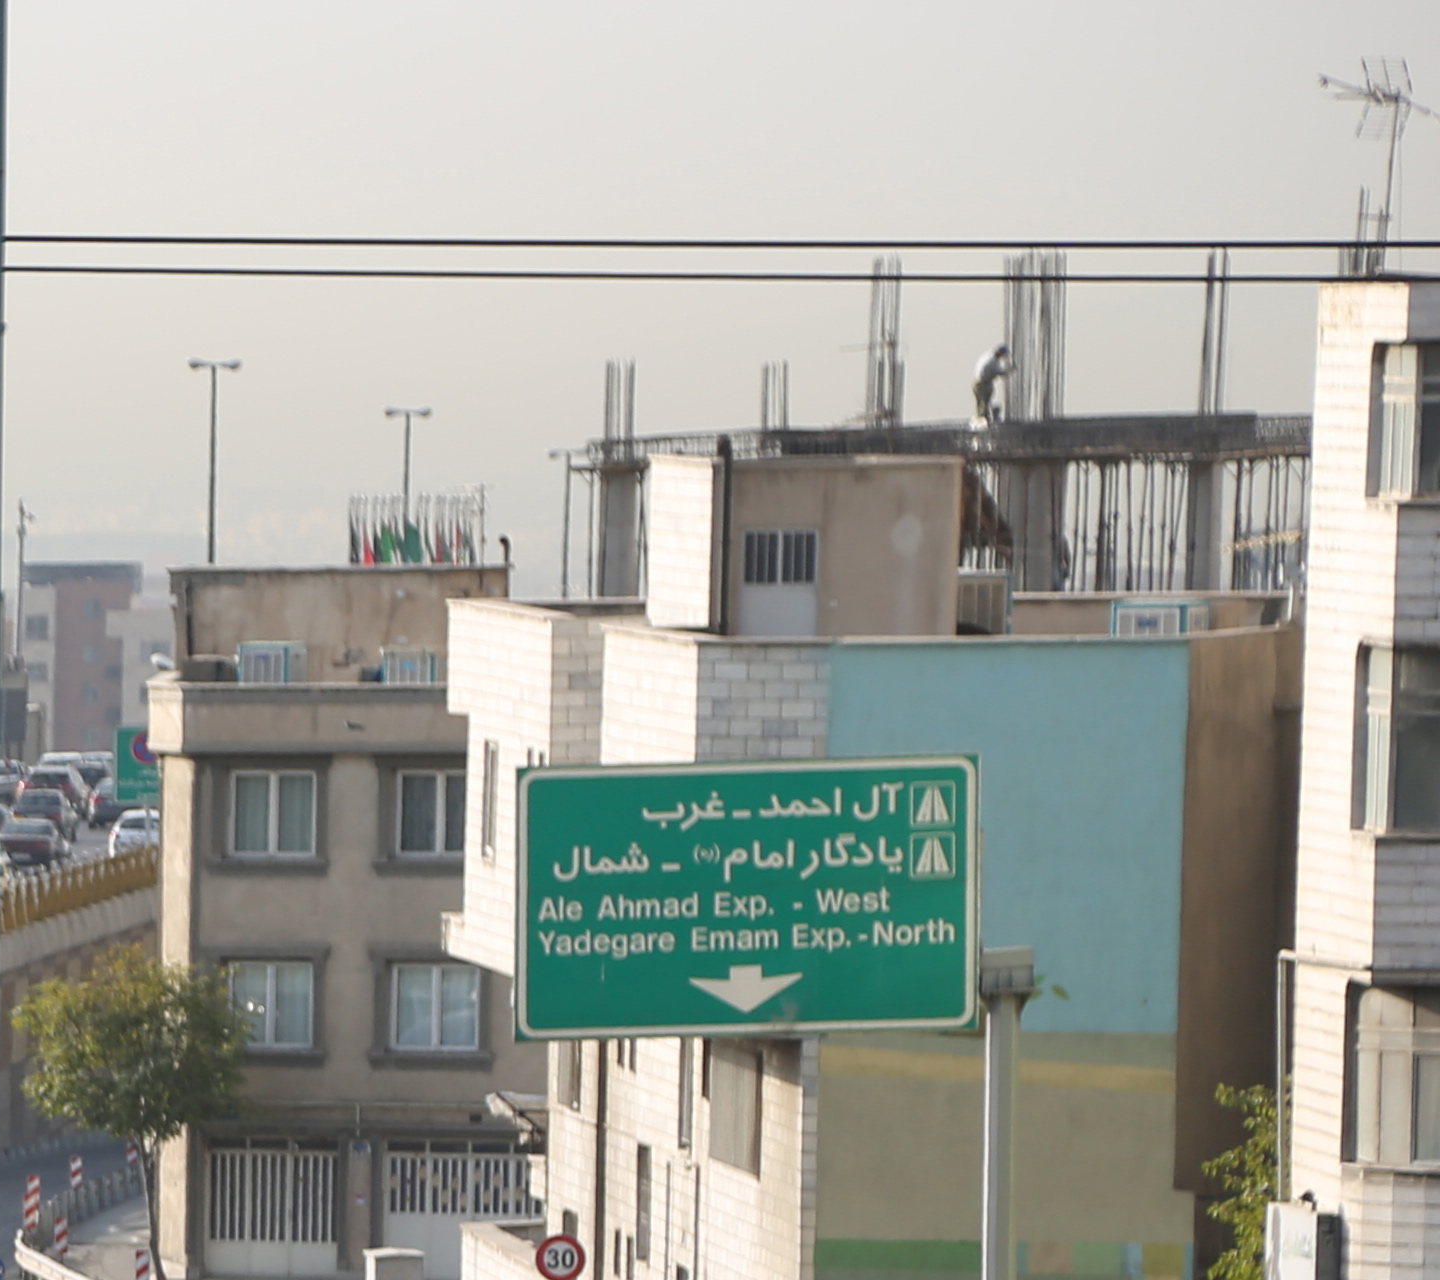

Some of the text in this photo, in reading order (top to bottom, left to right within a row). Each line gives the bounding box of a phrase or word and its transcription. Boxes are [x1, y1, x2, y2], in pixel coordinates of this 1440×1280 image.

[640, 789, 727, 831] غرب
[757, 786, 843, 819] احمد
[551, 841, 651, 882] شمال
[722, 837, 796, 884] امام
[798, 833, 905, 880] یادگار
[537, 897, 585, 924] Ale
[596, 892, 700, 921] Ahmad
[712, 890, 776, 921] Exp.
[814, 886, 891, 915] West
[537, 930, 677, 961] Yadegare
[690, 923, 780, 953] Emam
[791, 923, 851, 954] Exp.
[546, 1247, 575, 1269] 30
